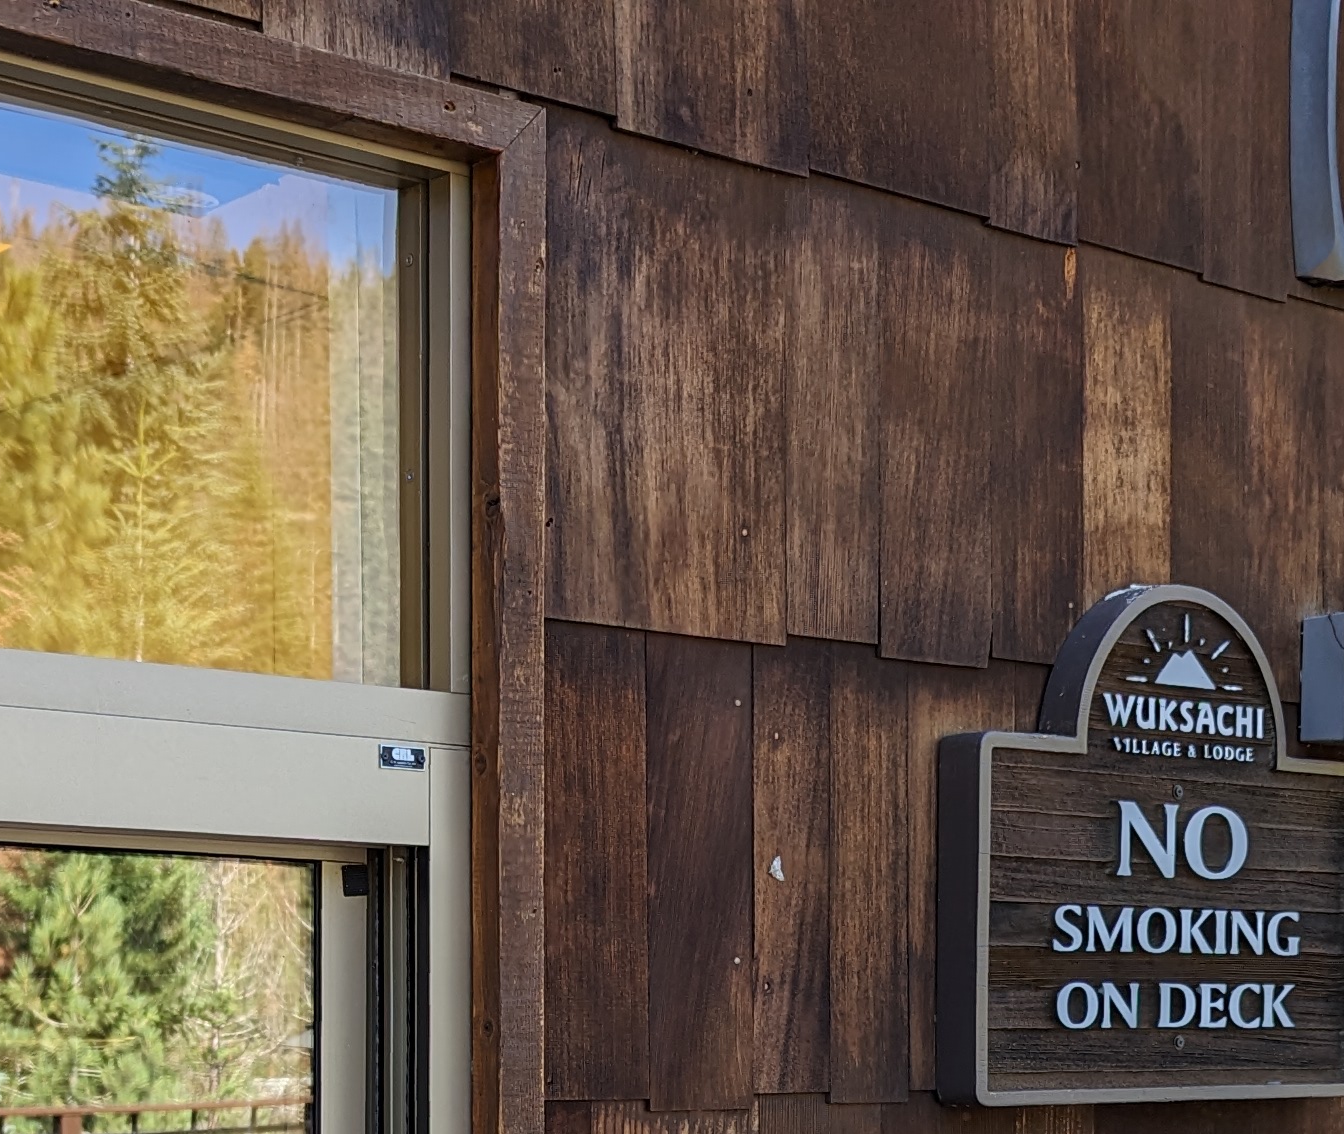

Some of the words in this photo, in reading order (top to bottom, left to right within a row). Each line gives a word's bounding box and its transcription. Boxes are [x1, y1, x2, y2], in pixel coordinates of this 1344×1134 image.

[1102, 692, 1265, 740] WUKSACHI
[1113, 736, 1182, 758] VILLAGE
[1187, 744, 1197, 759] &
[1203, 744, 1255, 763] LODGE
[1115, 800, 1249, 880] NO
[1052, 904, 1301, 957] SMOKING
[1056, 981, 1140, 1029] ON
[1156, 982, 1296, 1029] DECK
